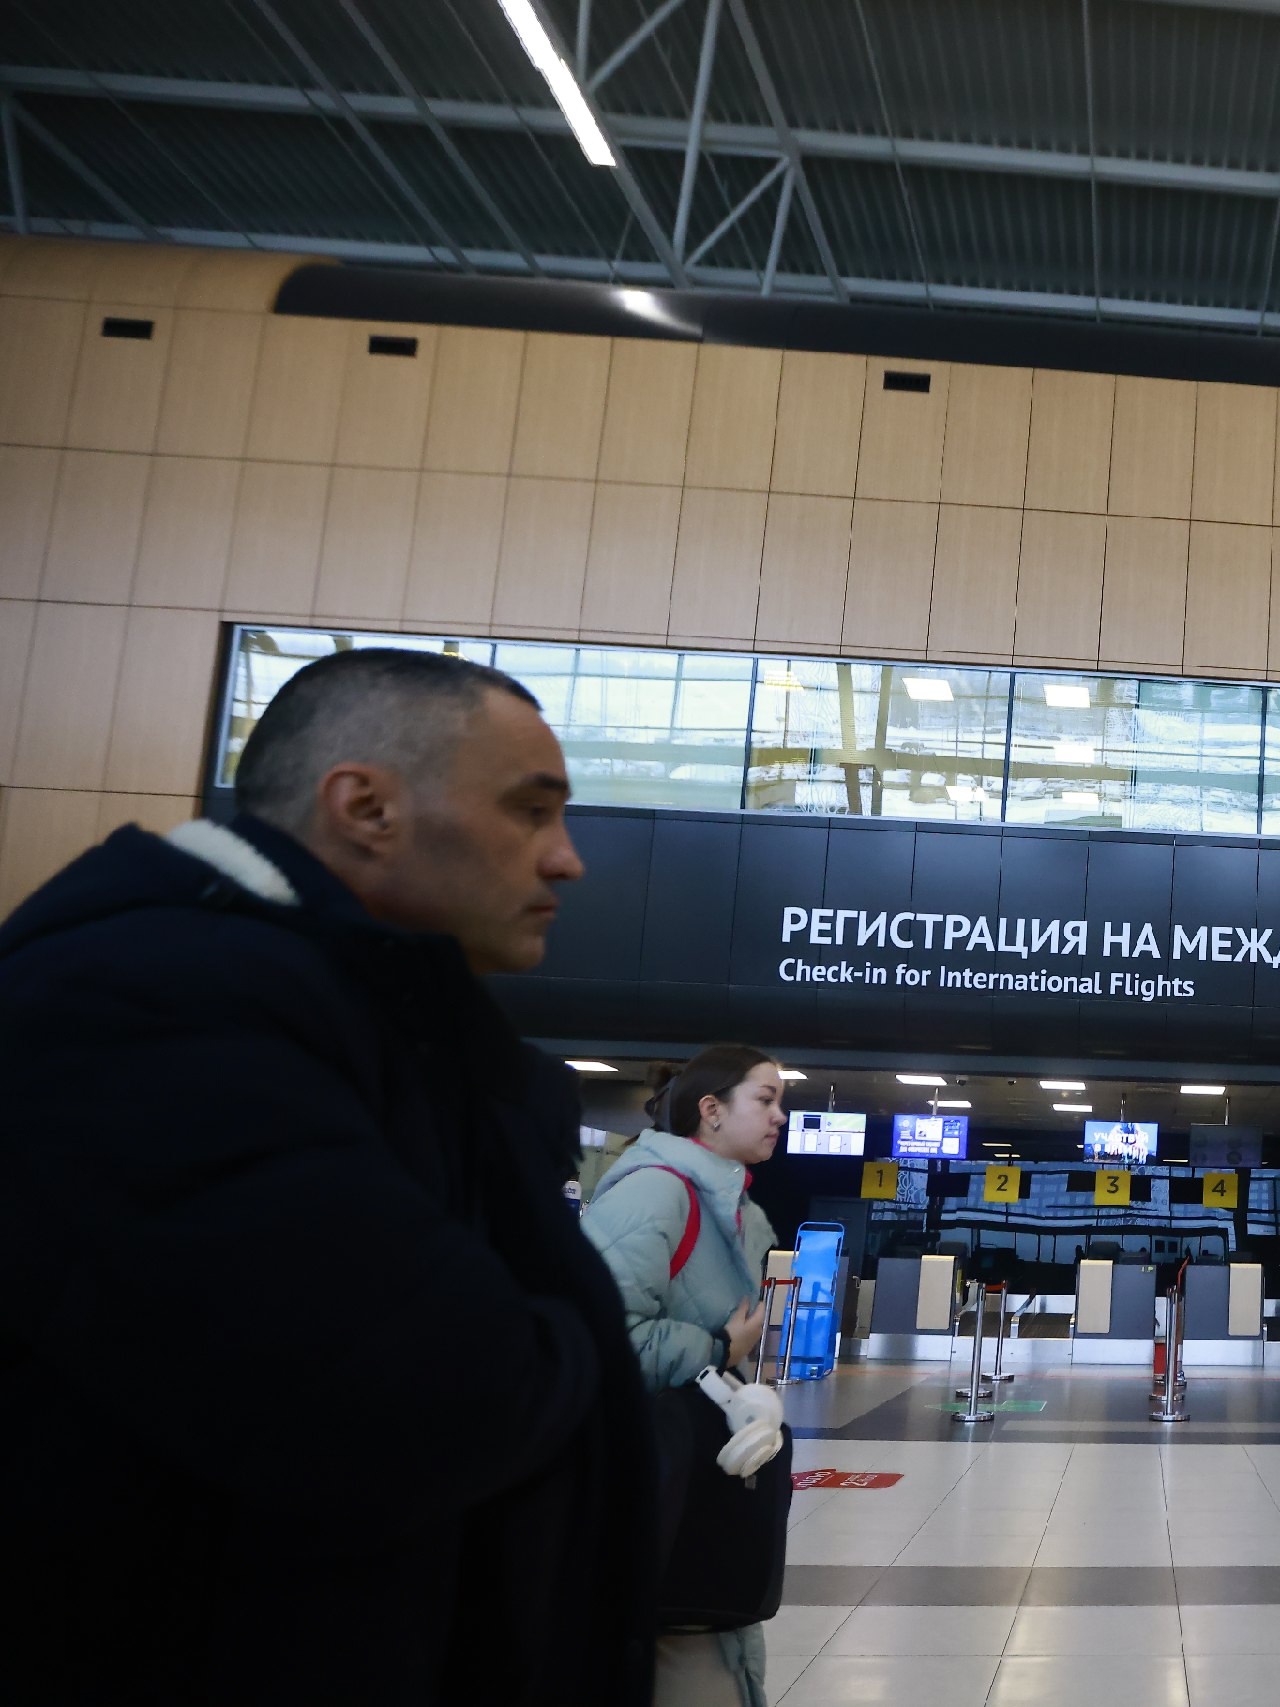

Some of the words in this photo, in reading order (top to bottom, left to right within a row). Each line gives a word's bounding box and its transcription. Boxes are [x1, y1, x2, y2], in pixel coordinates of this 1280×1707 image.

[781, 906, 1087, 959] РЕГИСТРАЦИЯ
[1102, 922, 1162, 959] НА
[778, 957, 887, 985] Check-in
[896, 963, 931, 988] for
[939, 965, 1102, 995] International
[1109, 972, 1195, 1002] Flights
[876, 1169, 884, 1188] 1
[996, 1174, 1009, 1192] 2
[1106, 1176, 1120, 1194] 3
[1211, 1179, 1227, 1197] 4
